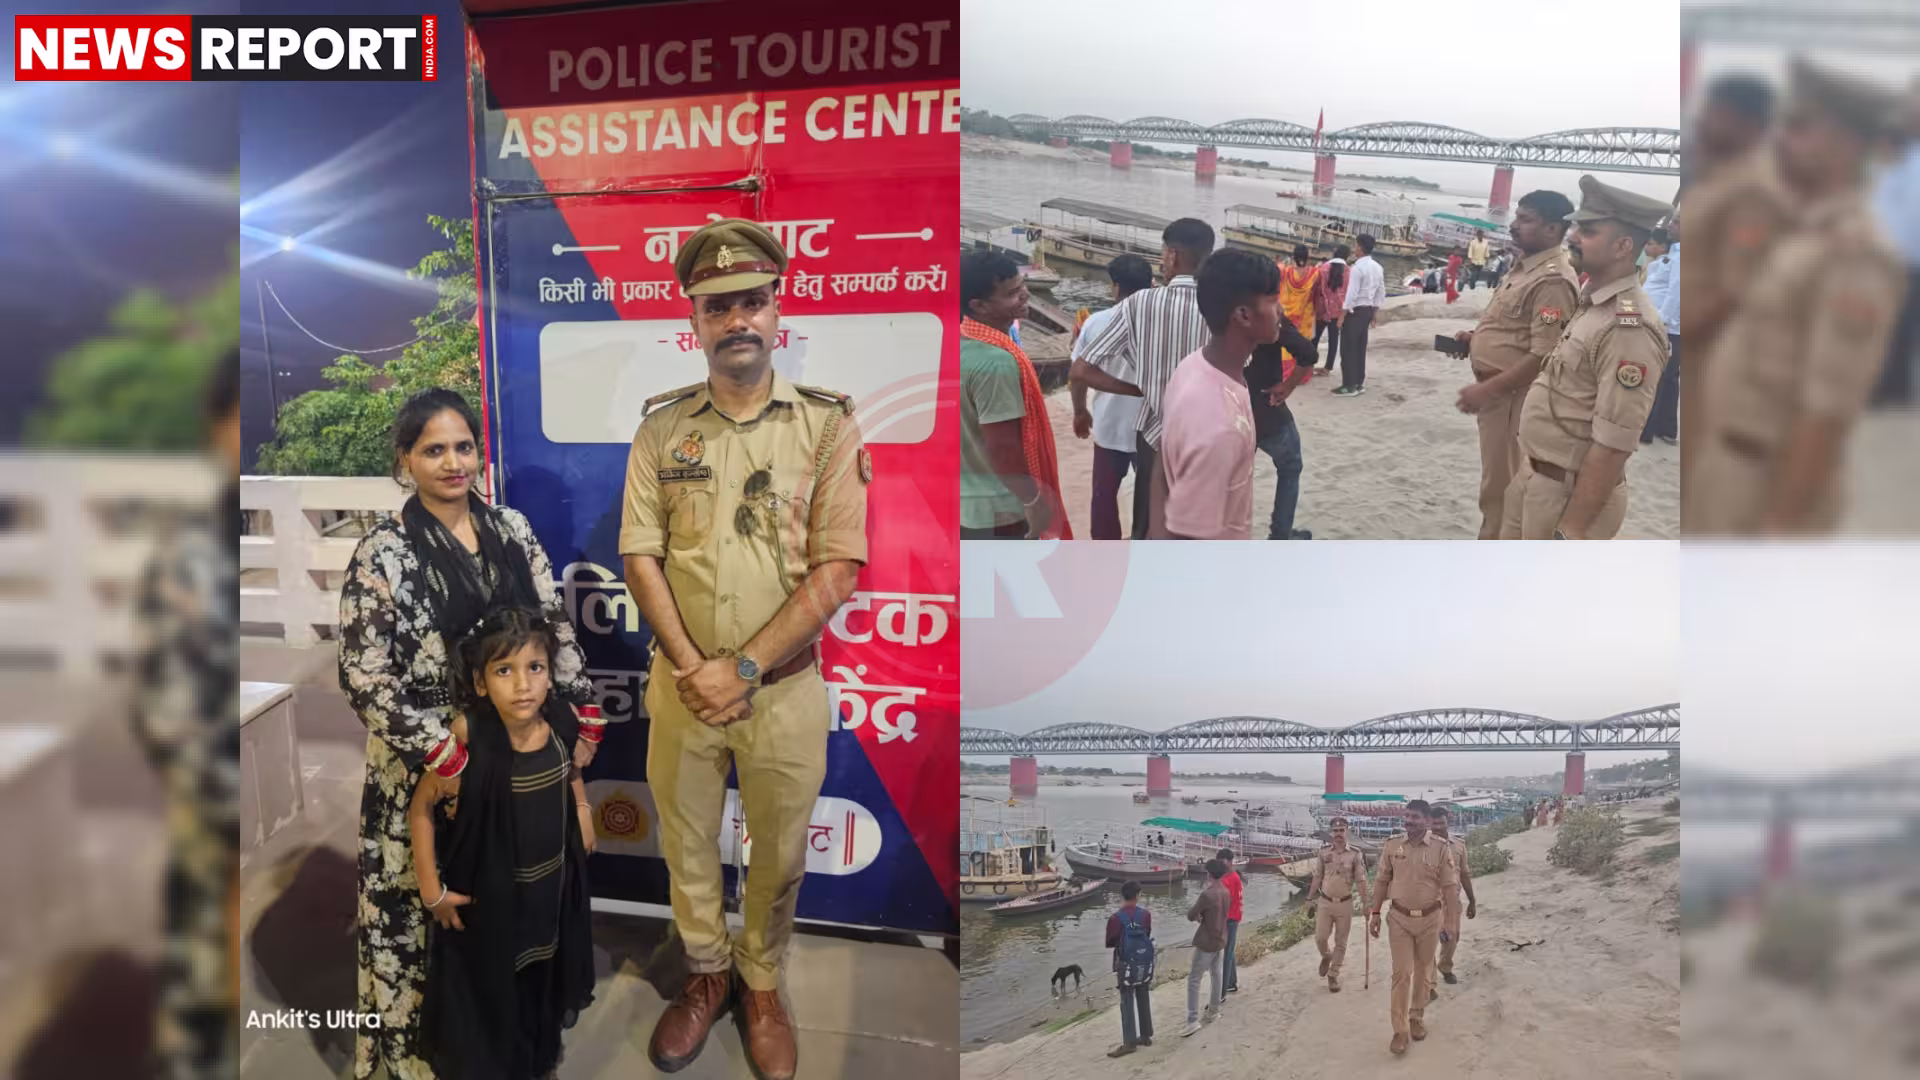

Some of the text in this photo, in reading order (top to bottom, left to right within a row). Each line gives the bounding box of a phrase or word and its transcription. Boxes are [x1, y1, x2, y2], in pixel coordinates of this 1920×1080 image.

[549, 20, 951, 93] POLICE TOURIST
[498, 88, 960, 160] ASSISTANCE CENTE
[539, 277, 587, 303] किसी
[592, 276, 616, 301] भी
[622, 281, 674, 303] प्रकार
[793, 270, 825, 300] हेतु
[831, 266, 899, 295] सम्पर्क
